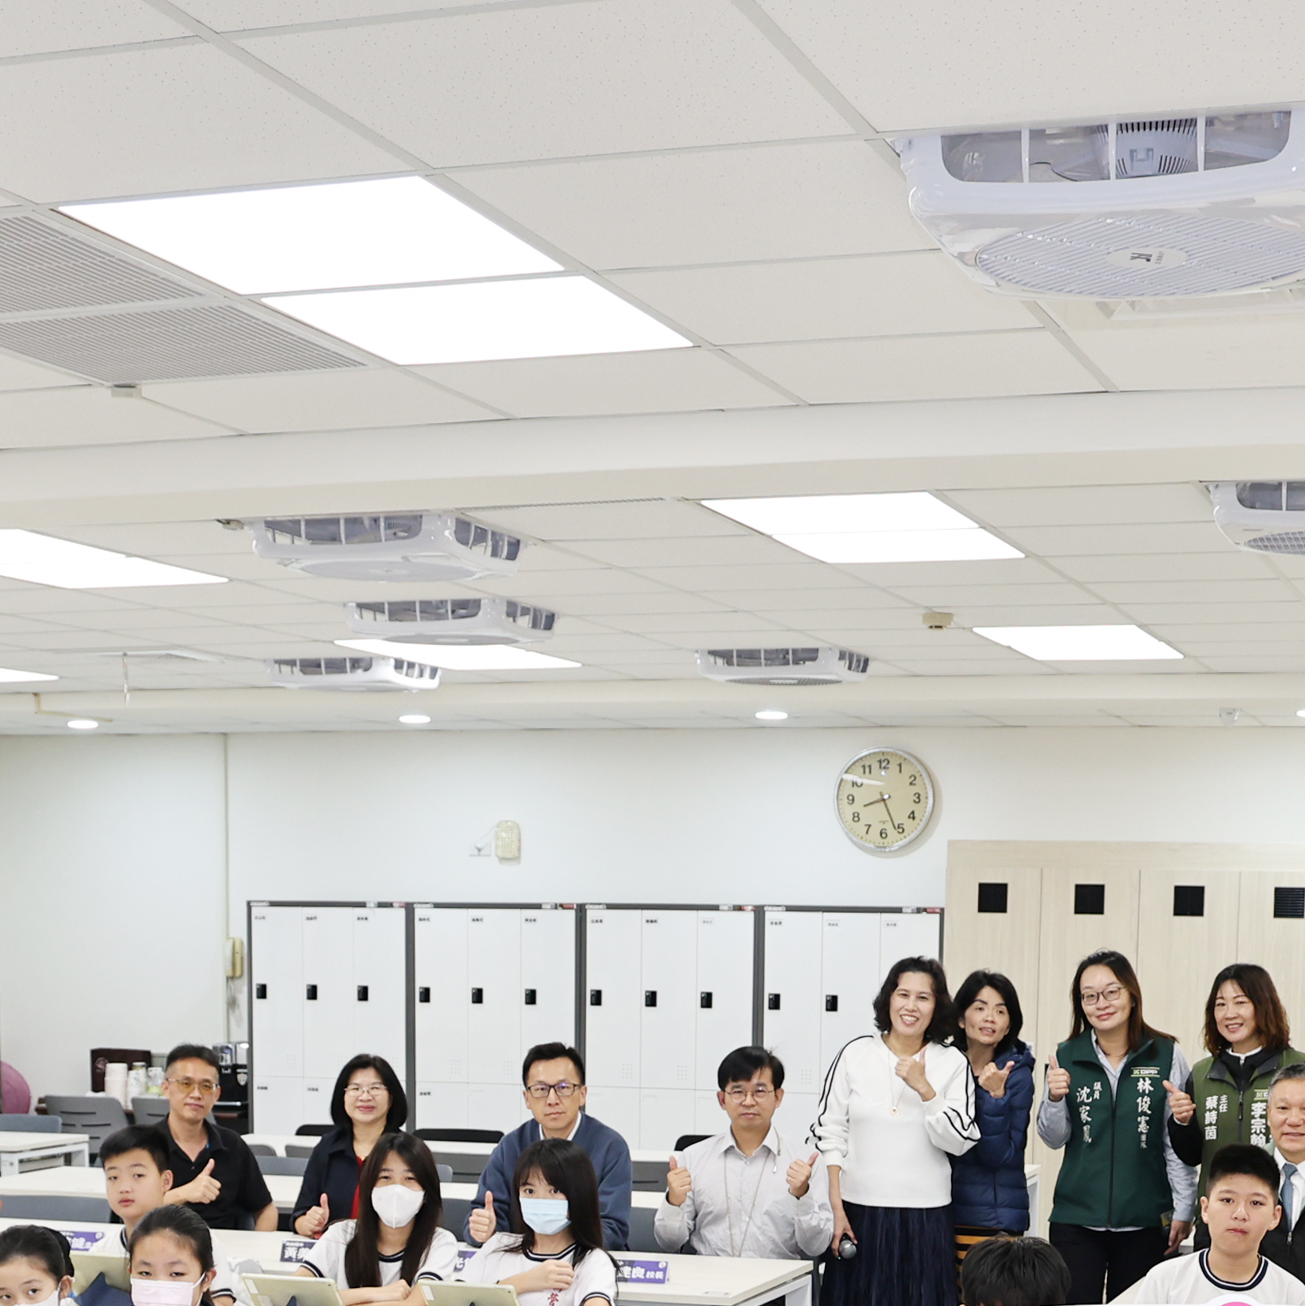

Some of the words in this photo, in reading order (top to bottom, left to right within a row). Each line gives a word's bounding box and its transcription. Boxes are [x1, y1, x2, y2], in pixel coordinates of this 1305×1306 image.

[861, 764, 872, 775] 11
[877, 758, 890, 770] 12
[897, 762, 902, 774] 1
[909, 774, 917, 786] 2
[846, 794, 855, 805] 9
[913, 792, 921, 804] 3
[852, 811, 861, 823] 8
[908, 810, 916, 821] 4
[864, 824, 872, 835] 7
[879, 828, 888, 839] 6
[897, 823, 905, 834] 5
[1219, 1094, 1228, 1113] 主任
